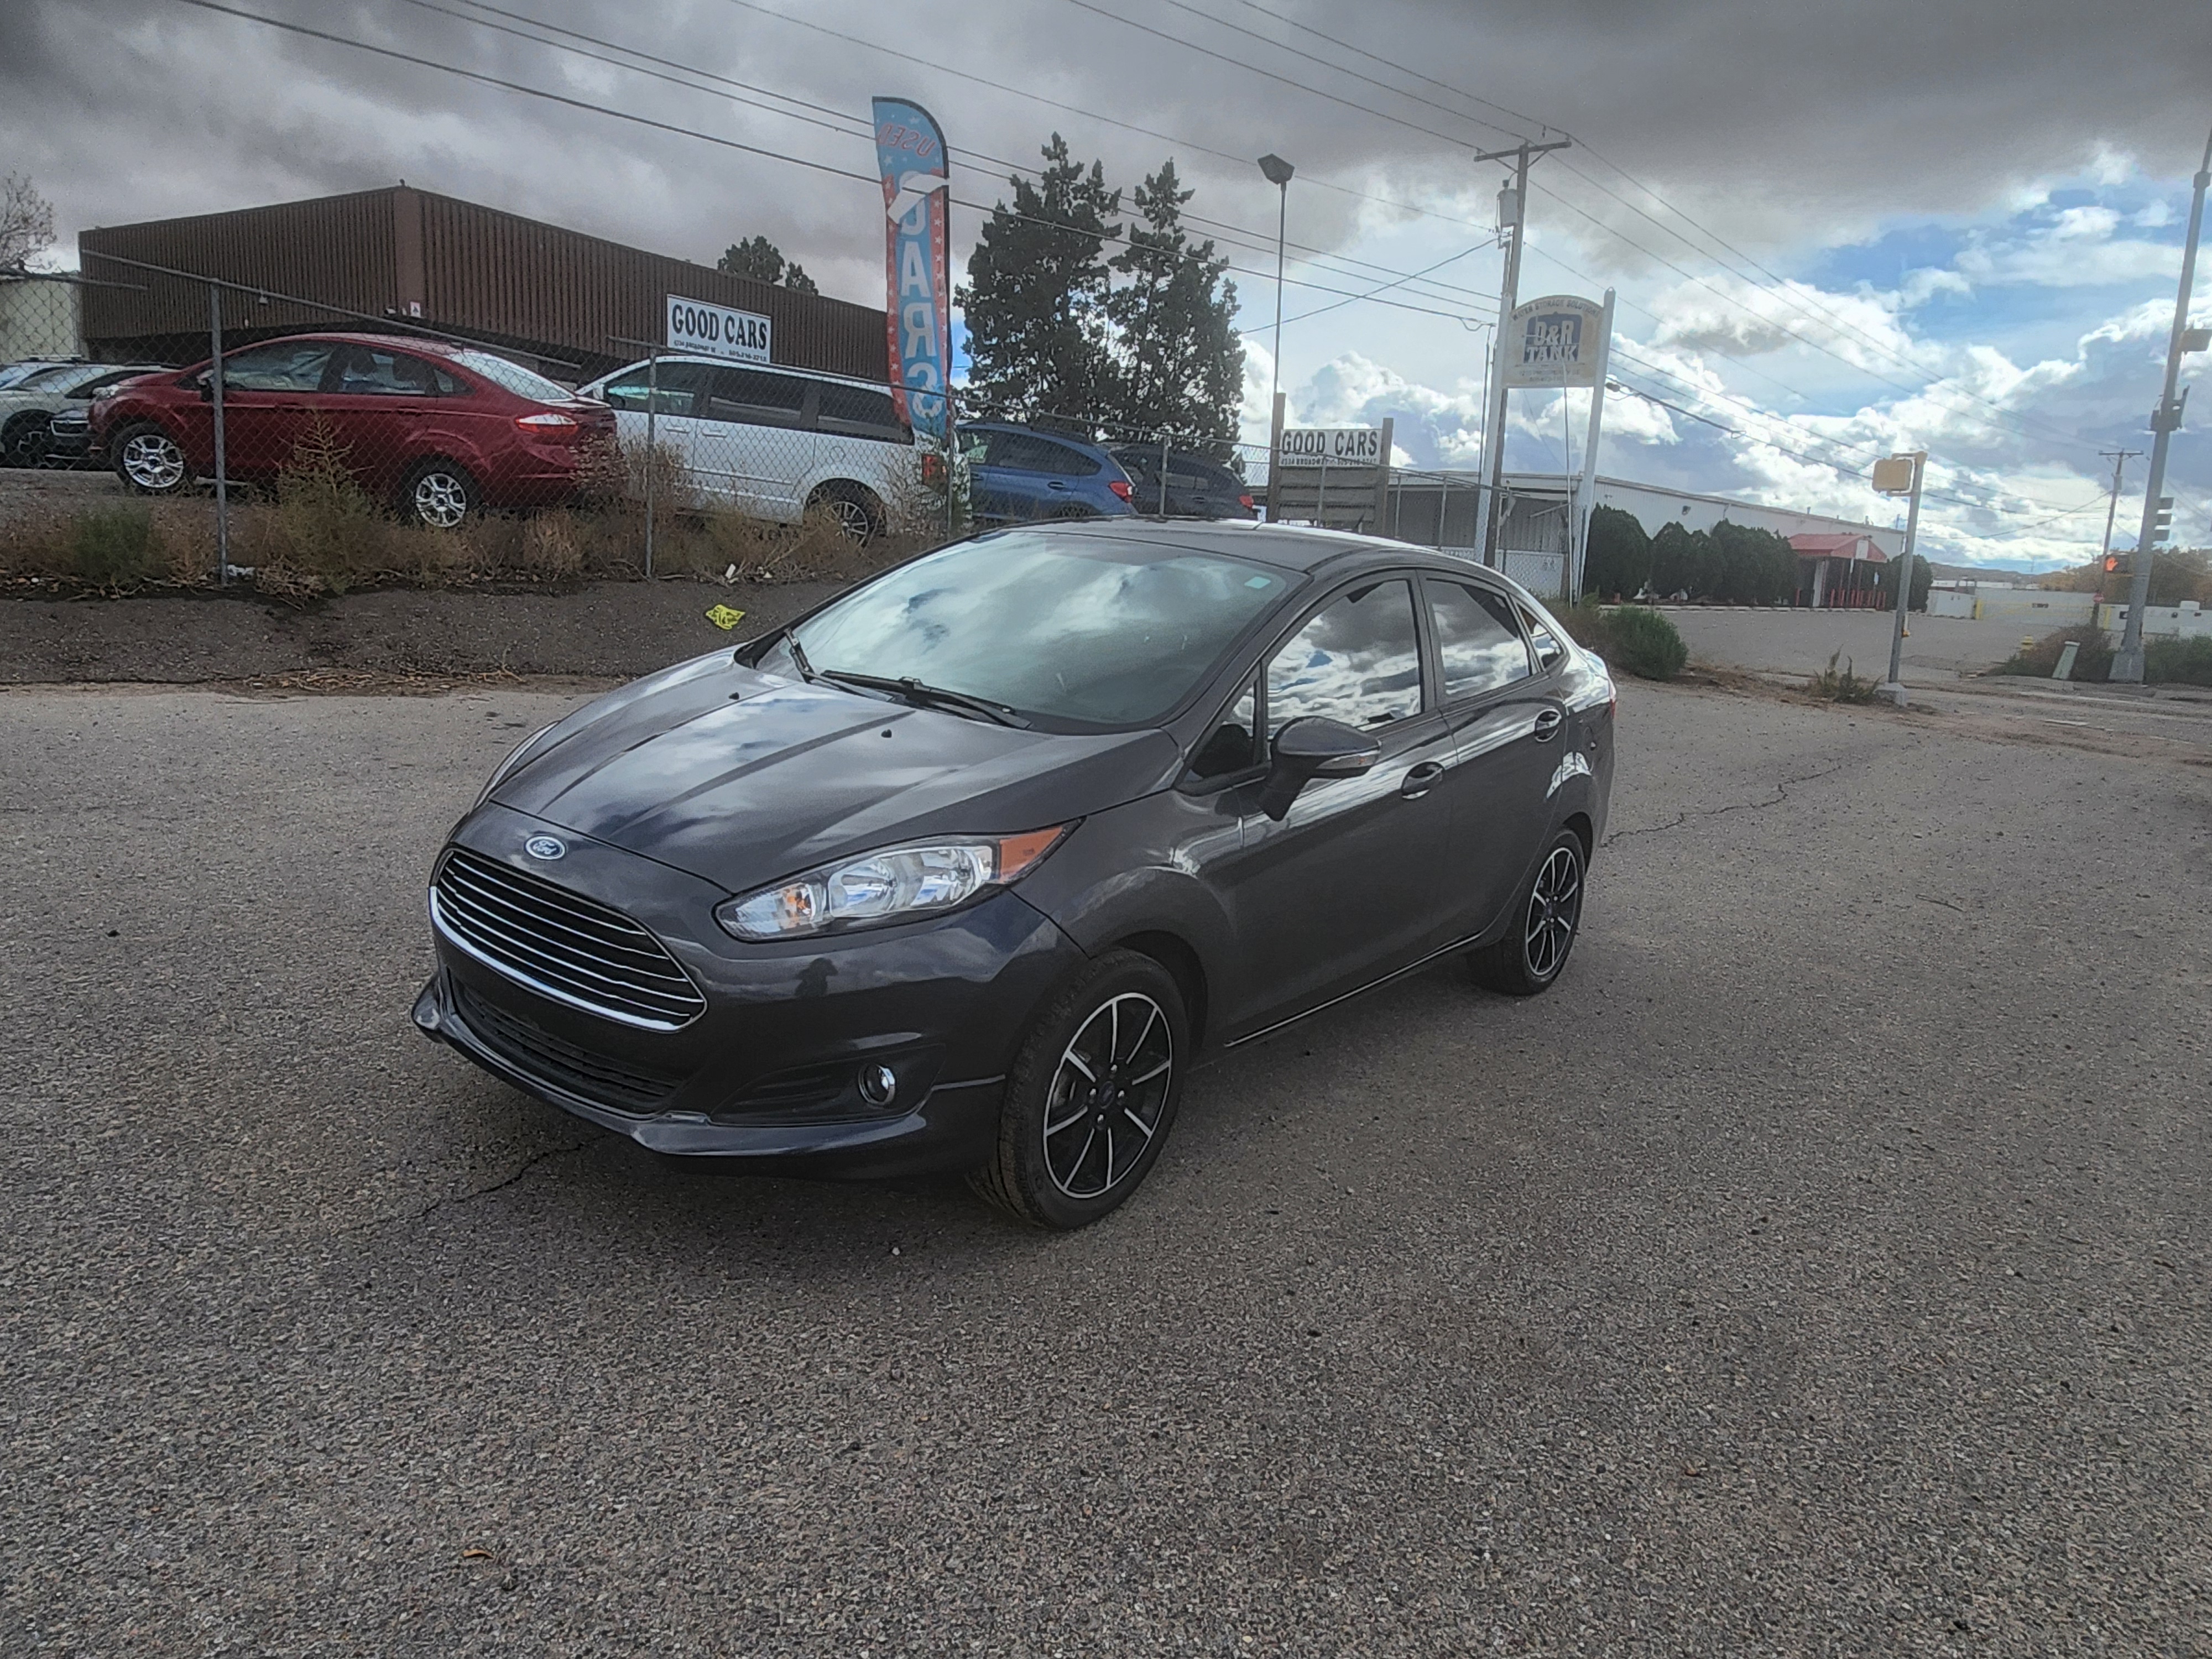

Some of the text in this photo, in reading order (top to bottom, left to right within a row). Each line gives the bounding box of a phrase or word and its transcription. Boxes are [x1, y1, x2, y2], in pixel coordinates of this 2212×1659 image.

[672, 304, 767, 350] GOOD CARS
[1533, 320, 1574, 345] D&R
[1526, 346, 1578, 363] TANK
[1282, 430, 1378, 456] GOOD CARS
